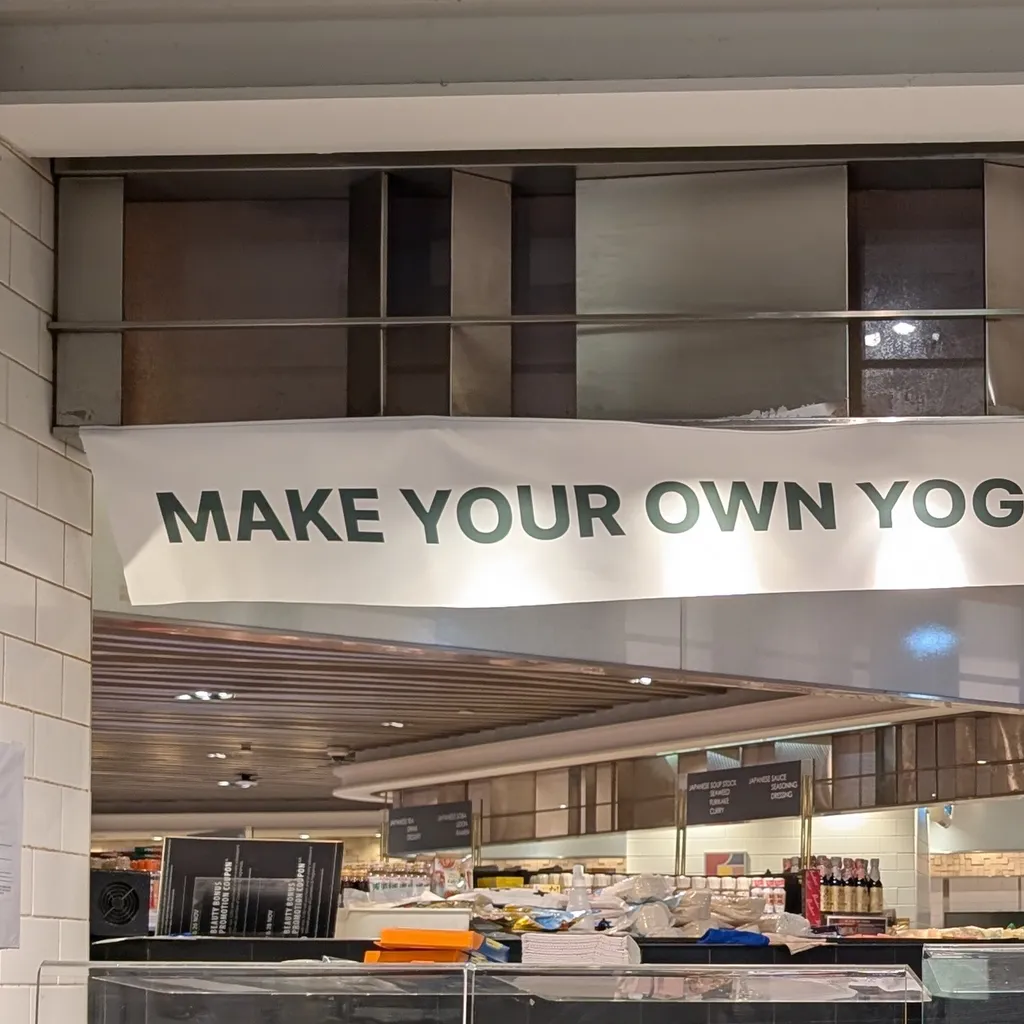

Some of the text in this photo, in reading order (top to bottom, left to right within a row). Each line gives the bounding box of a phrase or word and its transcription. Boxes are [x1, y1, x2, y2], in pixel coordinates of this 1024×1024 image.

[156, 488, 384, 543] MAKE
[400, 483, 626, 545] YOUR
[646, 480, 833, 533] OWN
[210, 881, 223, 934] BEAUTY BONUS
[219, 892, 230, 934] PROMOTION
[283, 882, 296, 934] BEAUTY BONUS
[292, 892, 303, 934] PROMOTION
